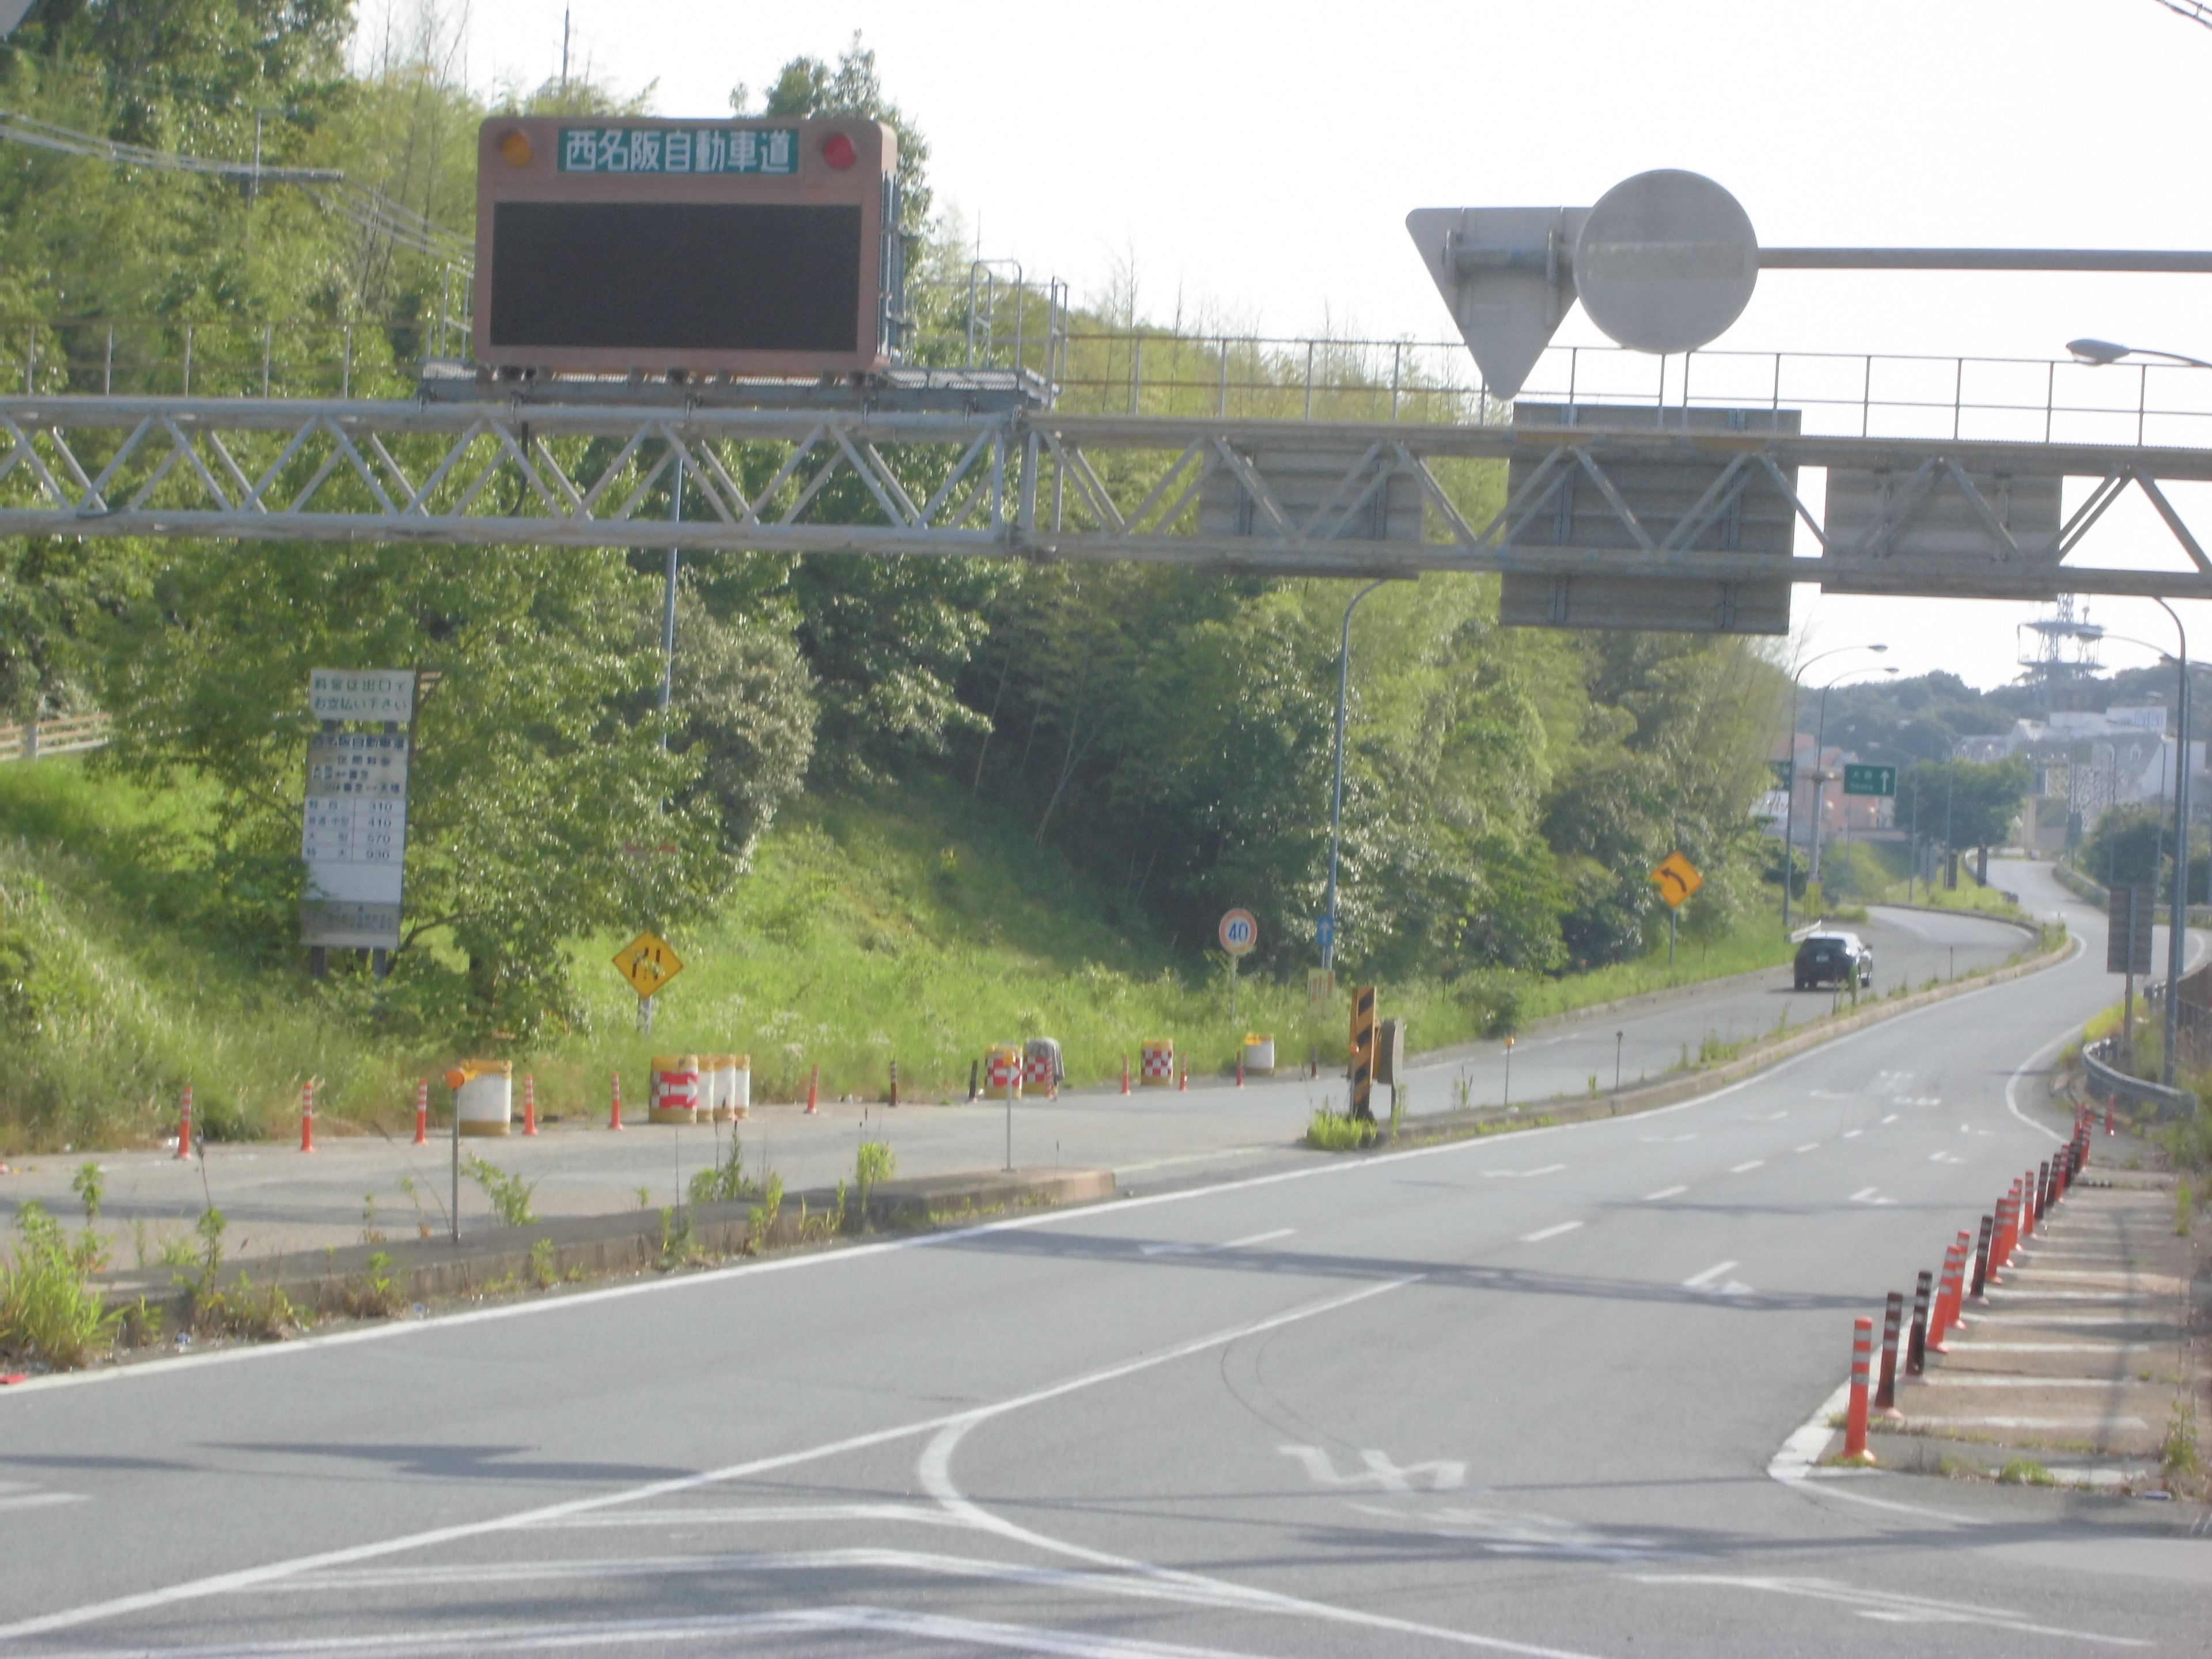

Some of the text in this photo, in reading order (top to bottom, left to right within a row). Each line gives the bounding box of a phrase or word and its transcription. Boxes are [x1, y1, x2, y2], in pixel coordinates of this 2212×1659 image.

[565, 130, 791, 173] 西名阪自動車道
[1229, 922, 1248, 942] 40
